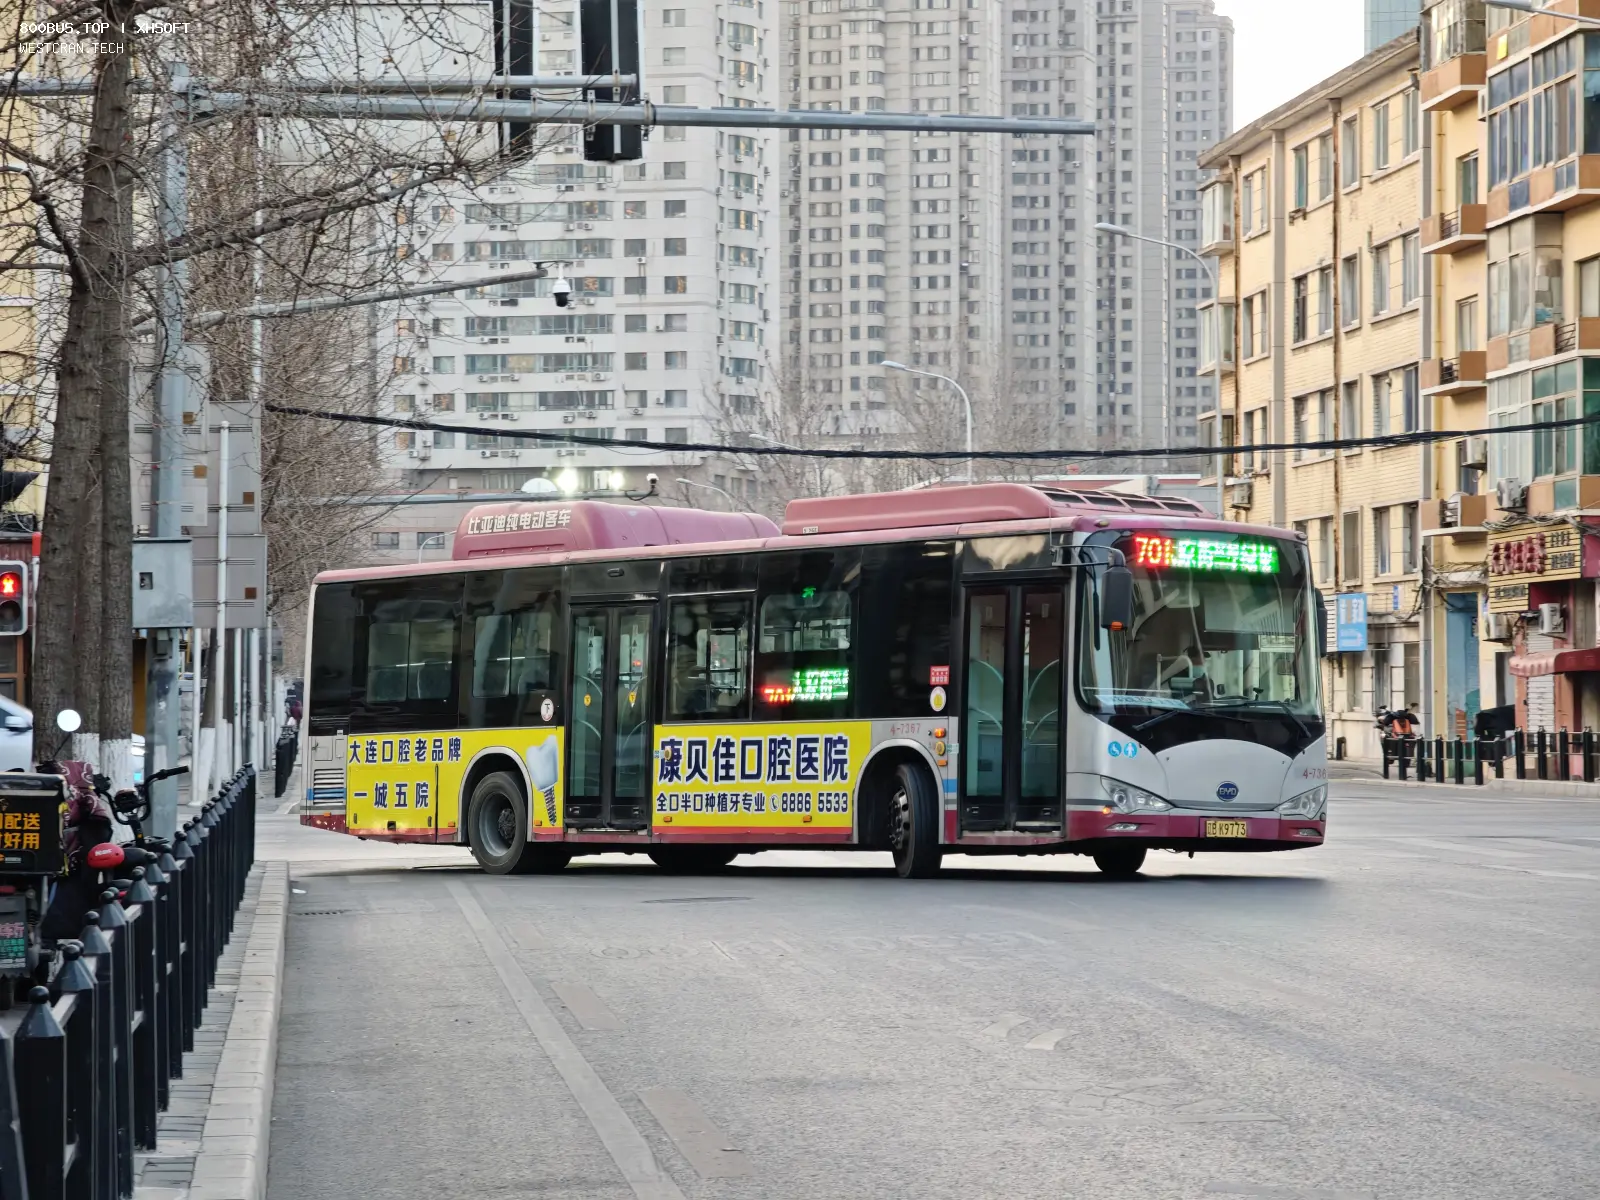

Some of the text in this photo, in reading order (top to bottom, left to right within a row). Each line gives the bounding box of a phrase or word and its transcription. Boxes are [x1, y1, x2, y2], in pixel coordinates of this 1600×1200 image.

[467, 509, 572, 535] 比亚迪纯电动客车
[890, 723, 921, 735] 4-7367
[349, 737, 461, 763] 大连口腔老品牌
[659, 736, 848, 783] 康贝佳口腔医院
[354, 782, 429, 808] 一城五院
[656, 792, 848, 812] 全口半口种植牙专业 8886 5533
[1219, 787, 1237, 796] BYD
